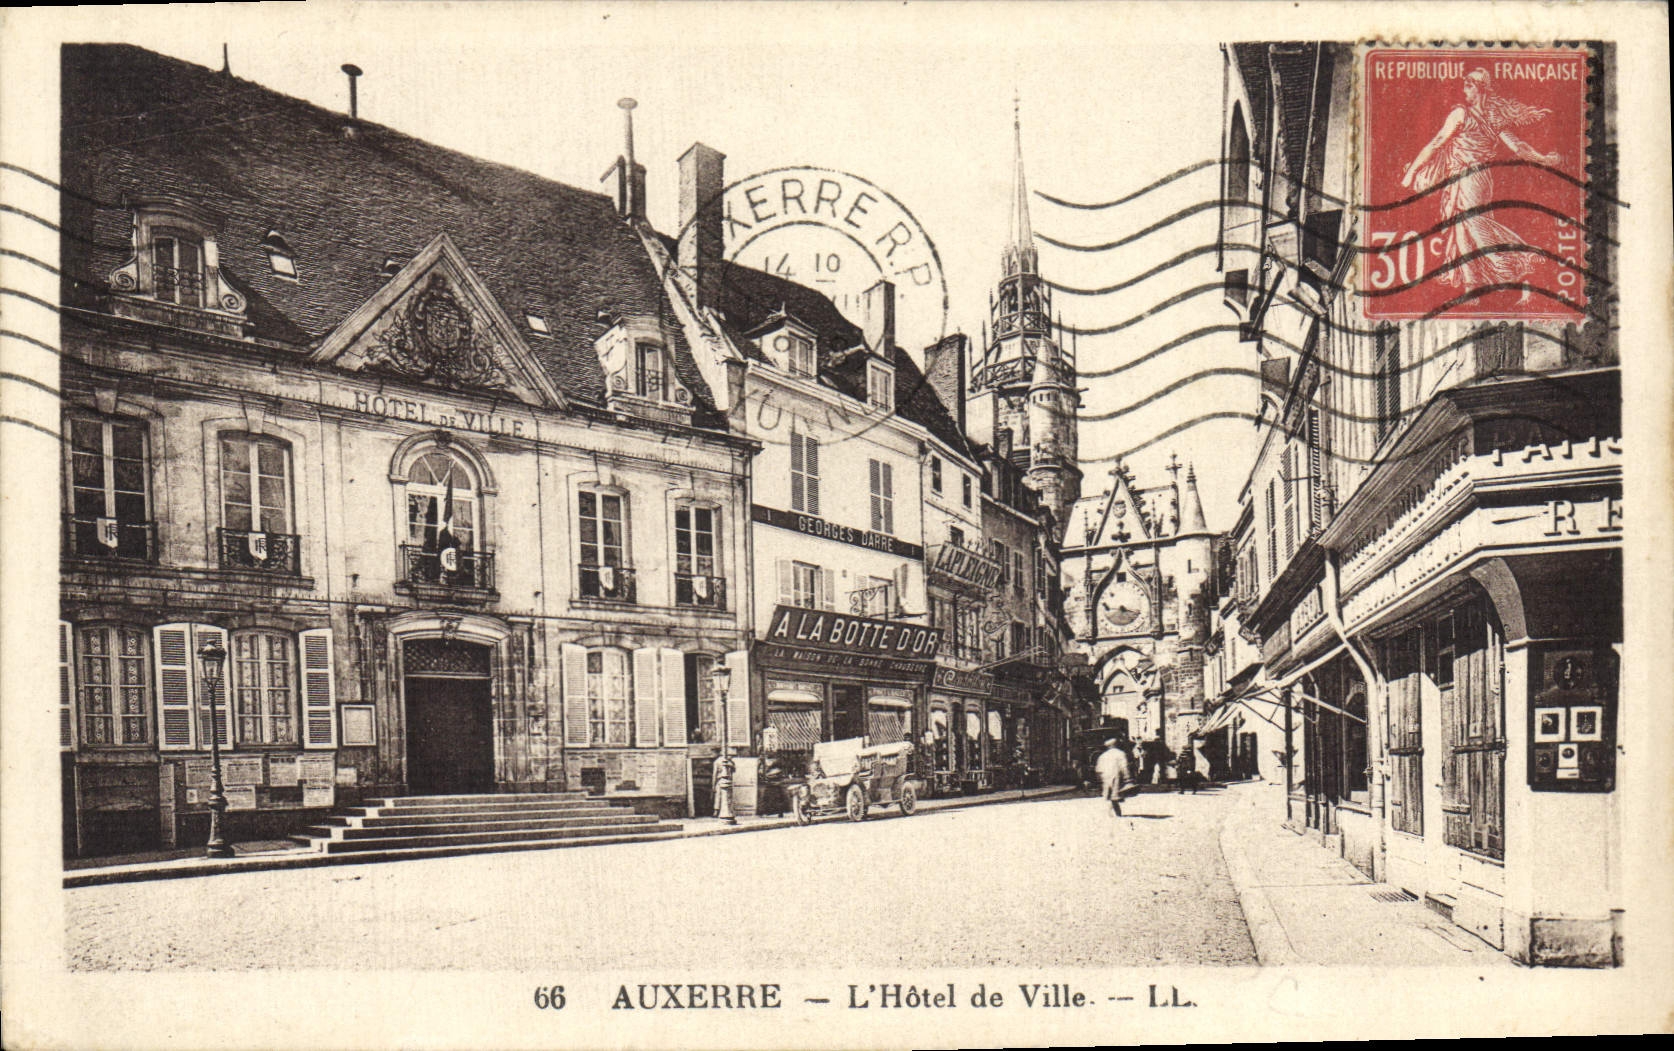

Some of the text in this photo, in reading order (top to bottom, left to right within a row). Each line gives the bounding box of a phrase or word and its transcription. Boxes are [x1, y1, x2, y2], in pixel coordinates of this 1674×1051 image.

[1375, 61, 1578, 83] REPUBLIQUE FRANÇAISE
[1370, 230, 1425, 290] 30
[1556, 216, 1578, 302] POSTES
[353, 391, 426, 425] HOTEL
[455, 408, 524, 438] VILLE
[798, 515, 894, 552] GEORGES DARRE
[774, 611, 938, 654] A LA BOTTE D'OR
[774, 648, 785, 658] LA
